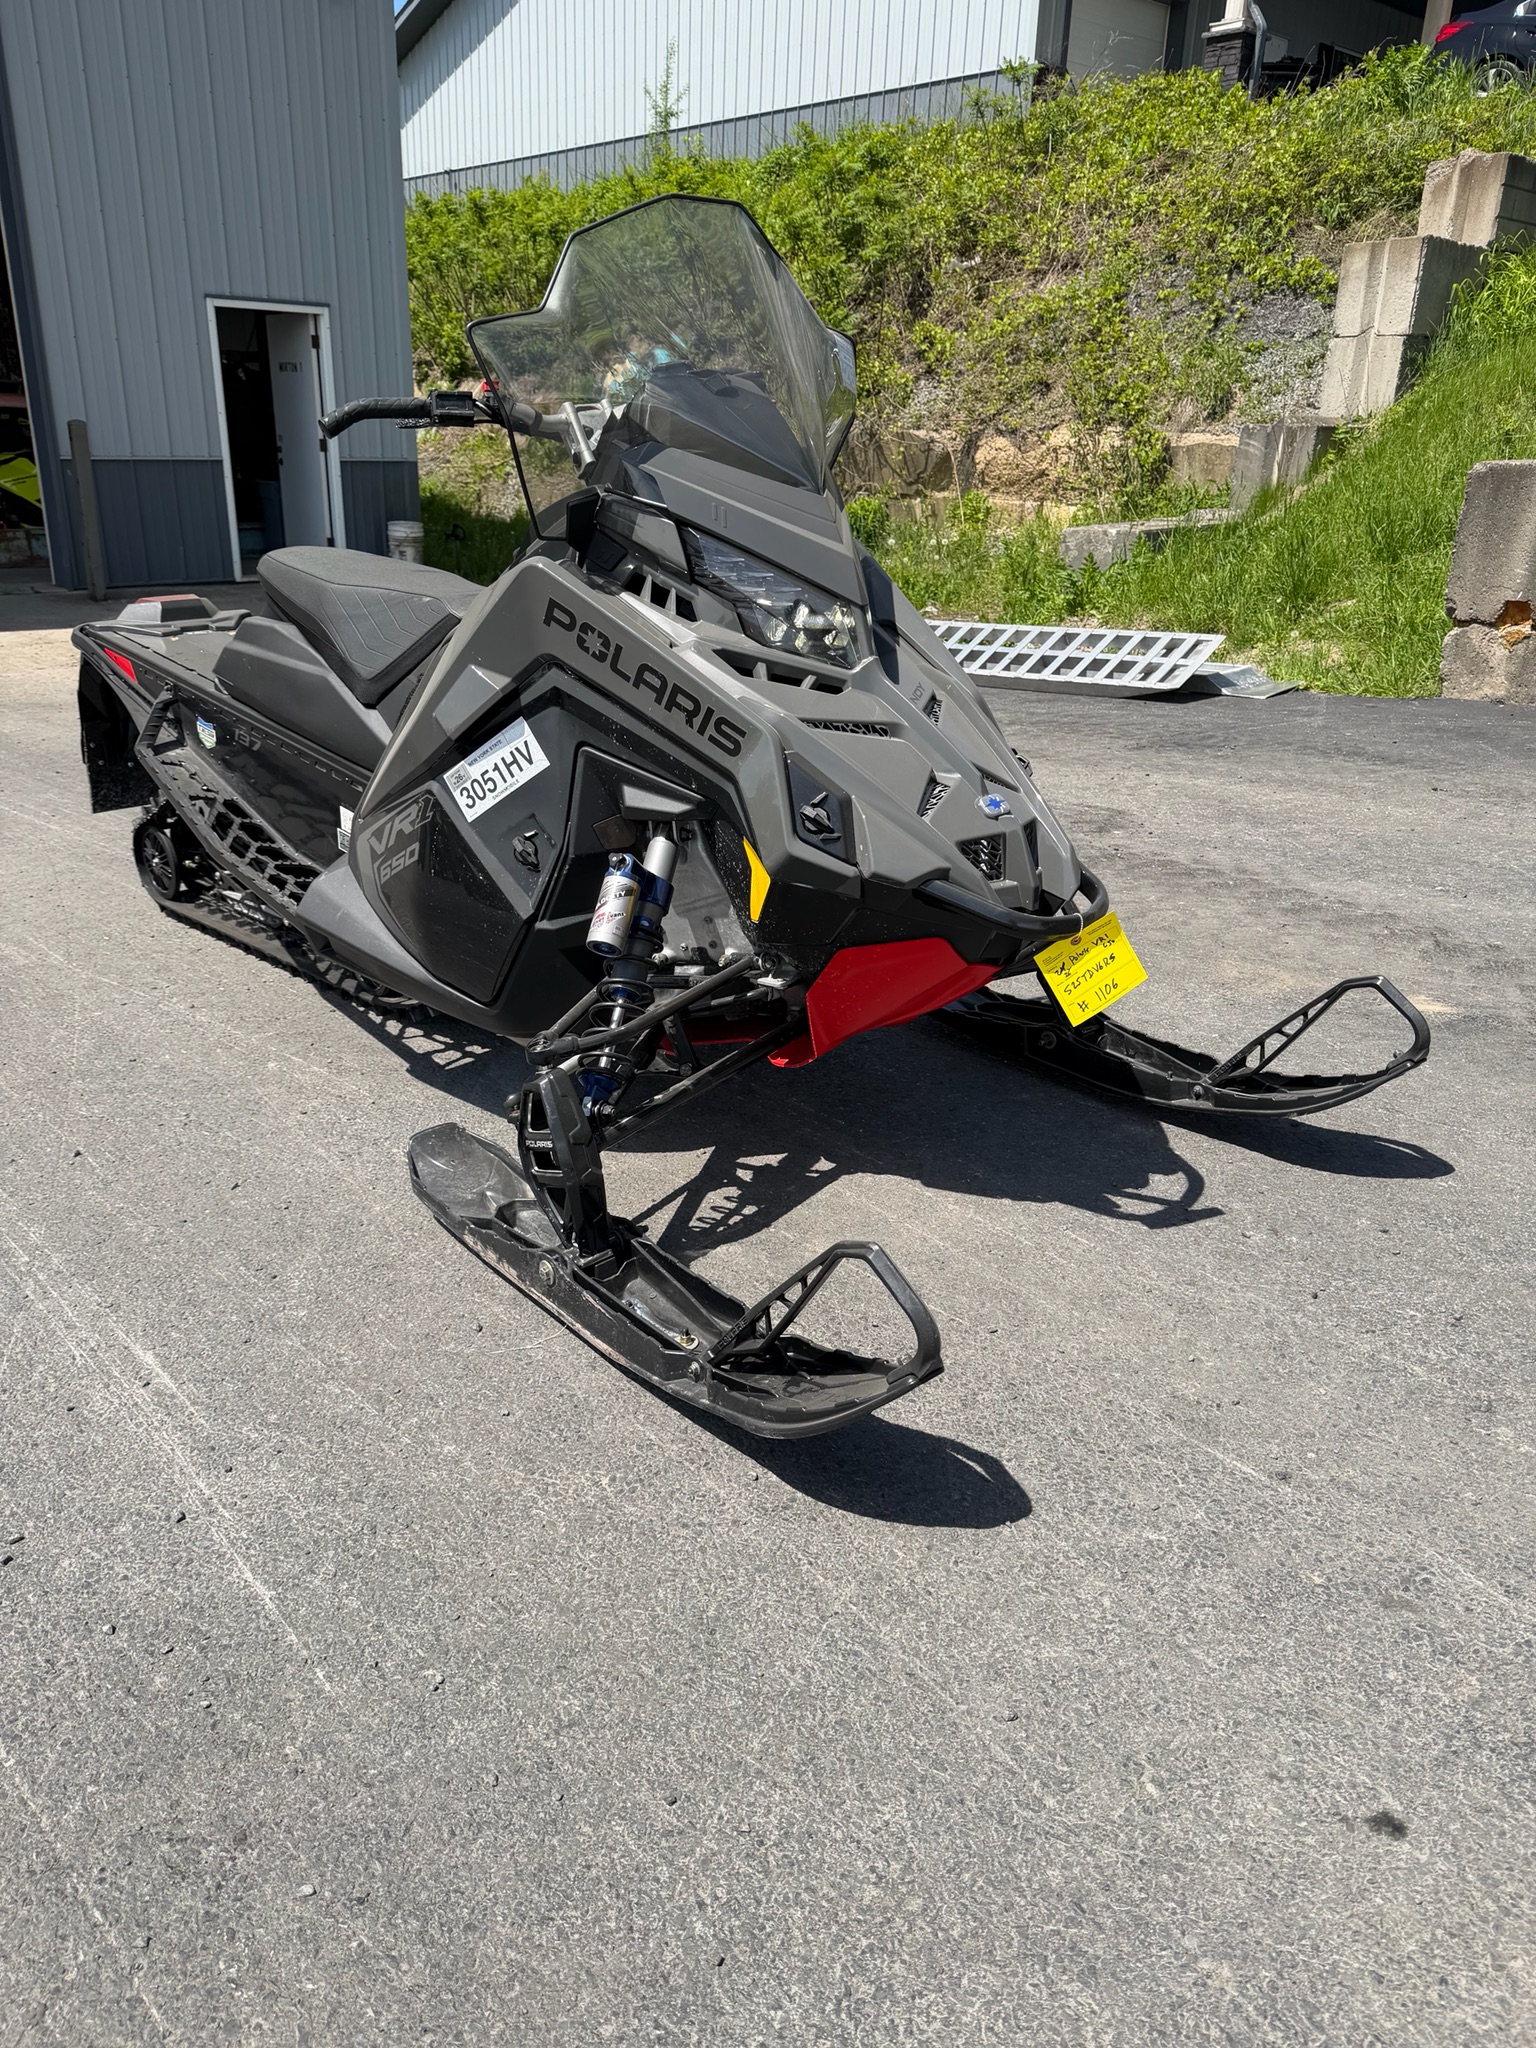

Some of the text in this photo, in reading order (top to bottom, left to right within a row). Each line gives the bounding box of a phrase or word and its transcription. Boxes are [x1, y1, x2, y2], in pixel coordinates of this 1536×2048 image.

[543, 597, 747, 757] POLARIS
[233, 727, 262, 751] 137
[467, 739, 503, 767] NEW YORK STATE
[459, 740, 534, 809] 3051HV
[492, 779, 520, 801] SNOWMOBILE
[368, 794, 434, 855] VR1
[380, 841, 420, 884] 650
[1094, 978, 1119, 1002] 1106
[525, 1139, 553, 1148] POLARIS
